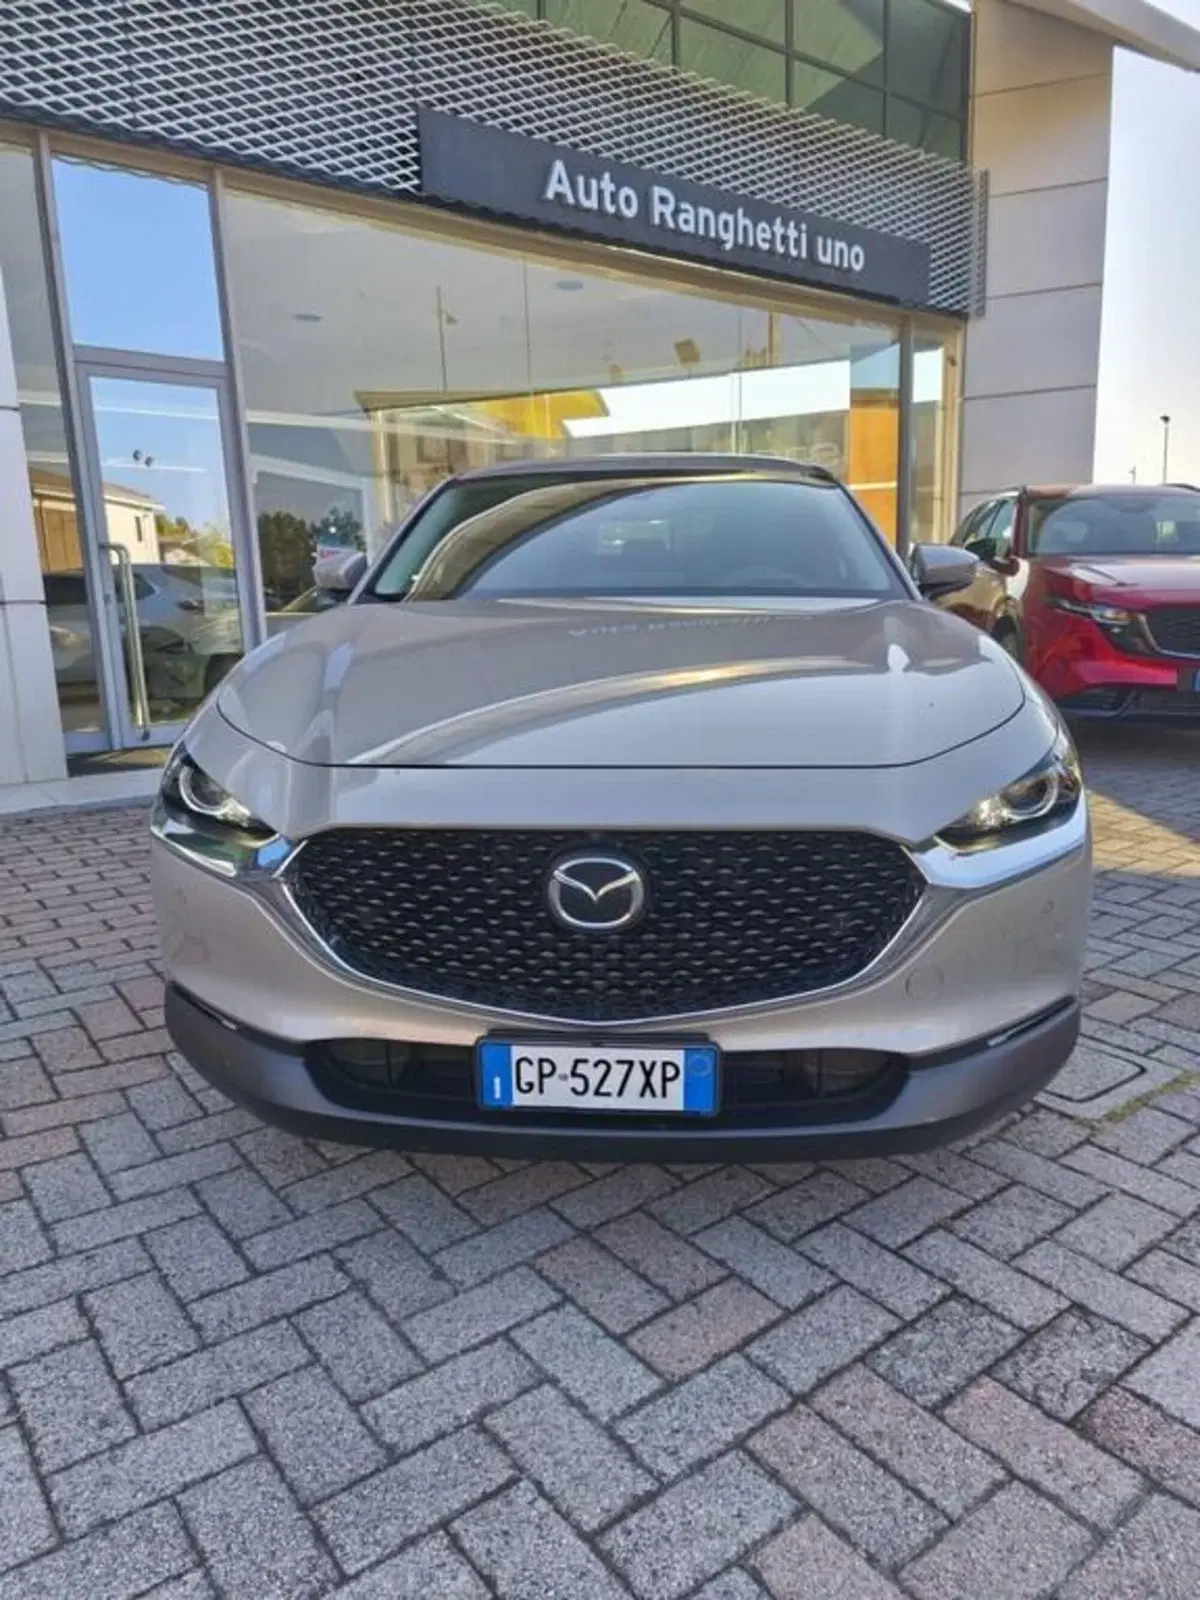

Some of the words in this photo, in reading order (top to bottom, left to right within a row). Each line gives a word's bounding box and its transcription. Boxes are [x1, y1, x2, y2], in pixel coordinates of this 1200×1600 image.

[546, 160, 638, 218] Auto
[652, 185, 807, 259] Ranghetti
[817, 235, 865, 271] uno
